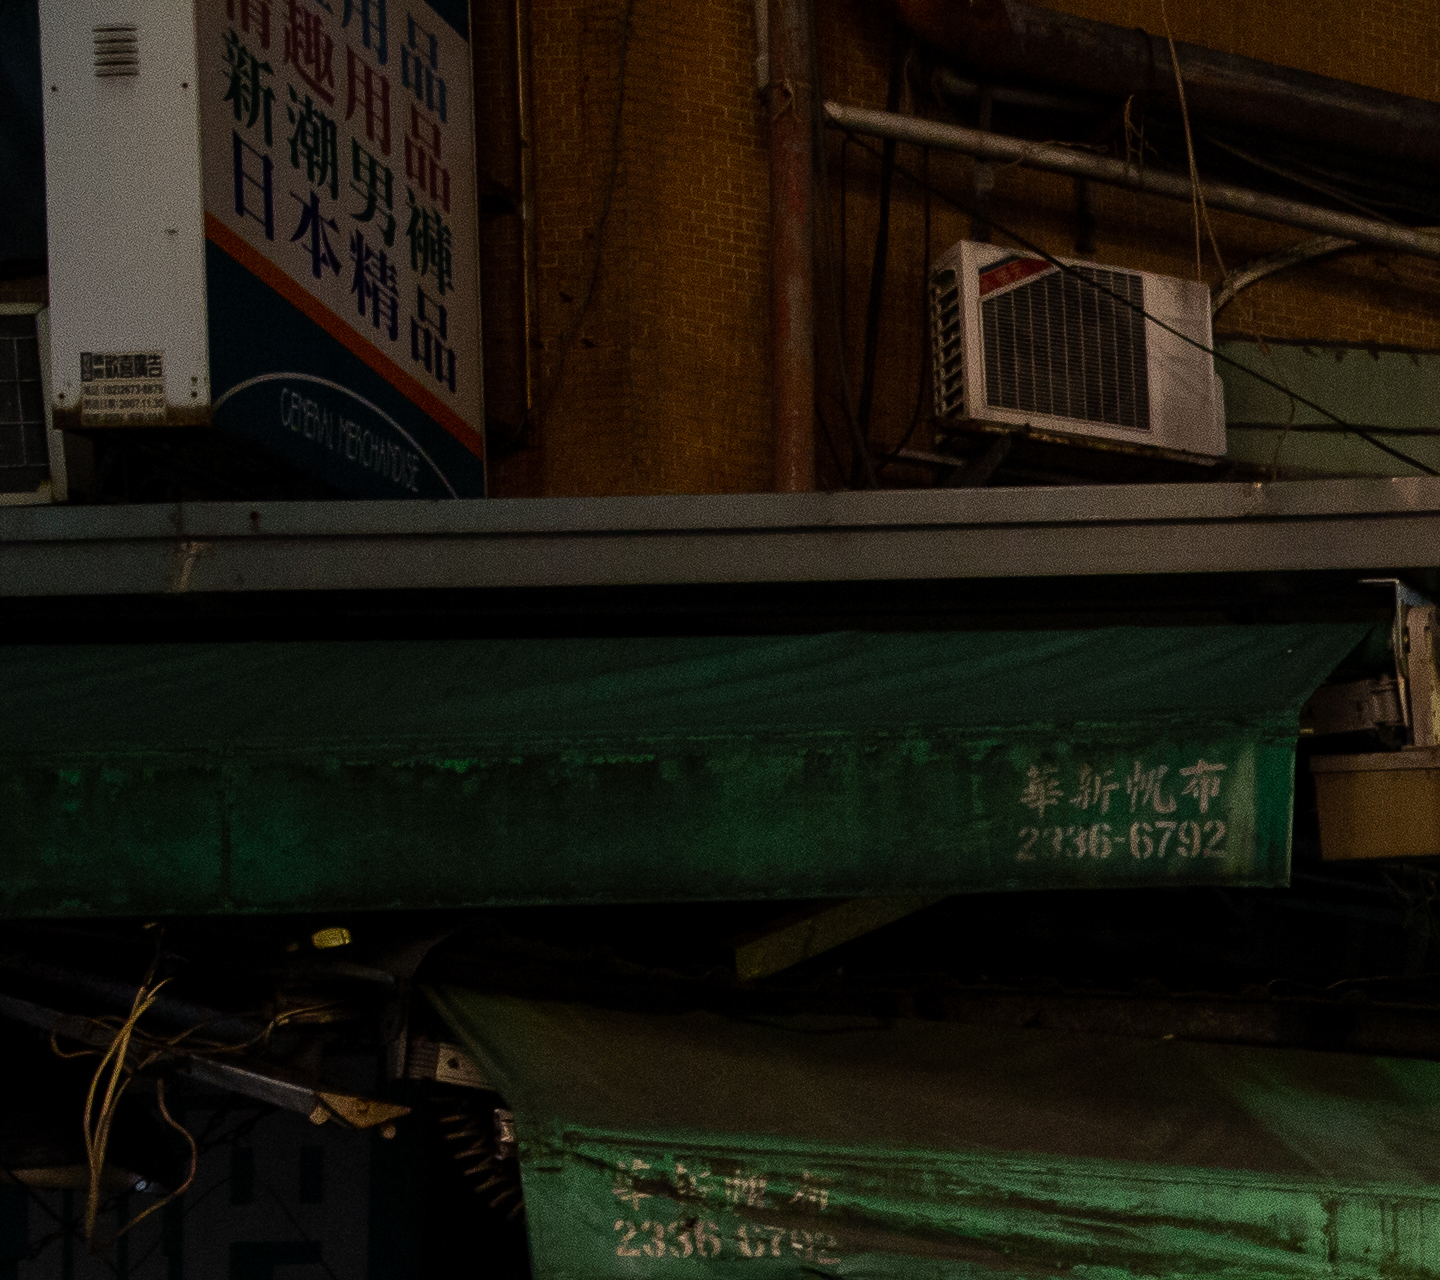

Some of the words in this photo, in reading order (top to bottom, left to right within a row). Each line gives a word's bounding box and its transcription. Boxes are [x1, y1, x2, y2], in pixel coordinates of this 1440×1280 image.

[315, 0, 447, 122] 用品
[223, 28, 454, 295] 新潮男褲
[232, 130, 456, 393] 日本精品
[1015, 820, 1230, 863] 2336-6792
[1018, 758, 1228, 816] 華新帆布
